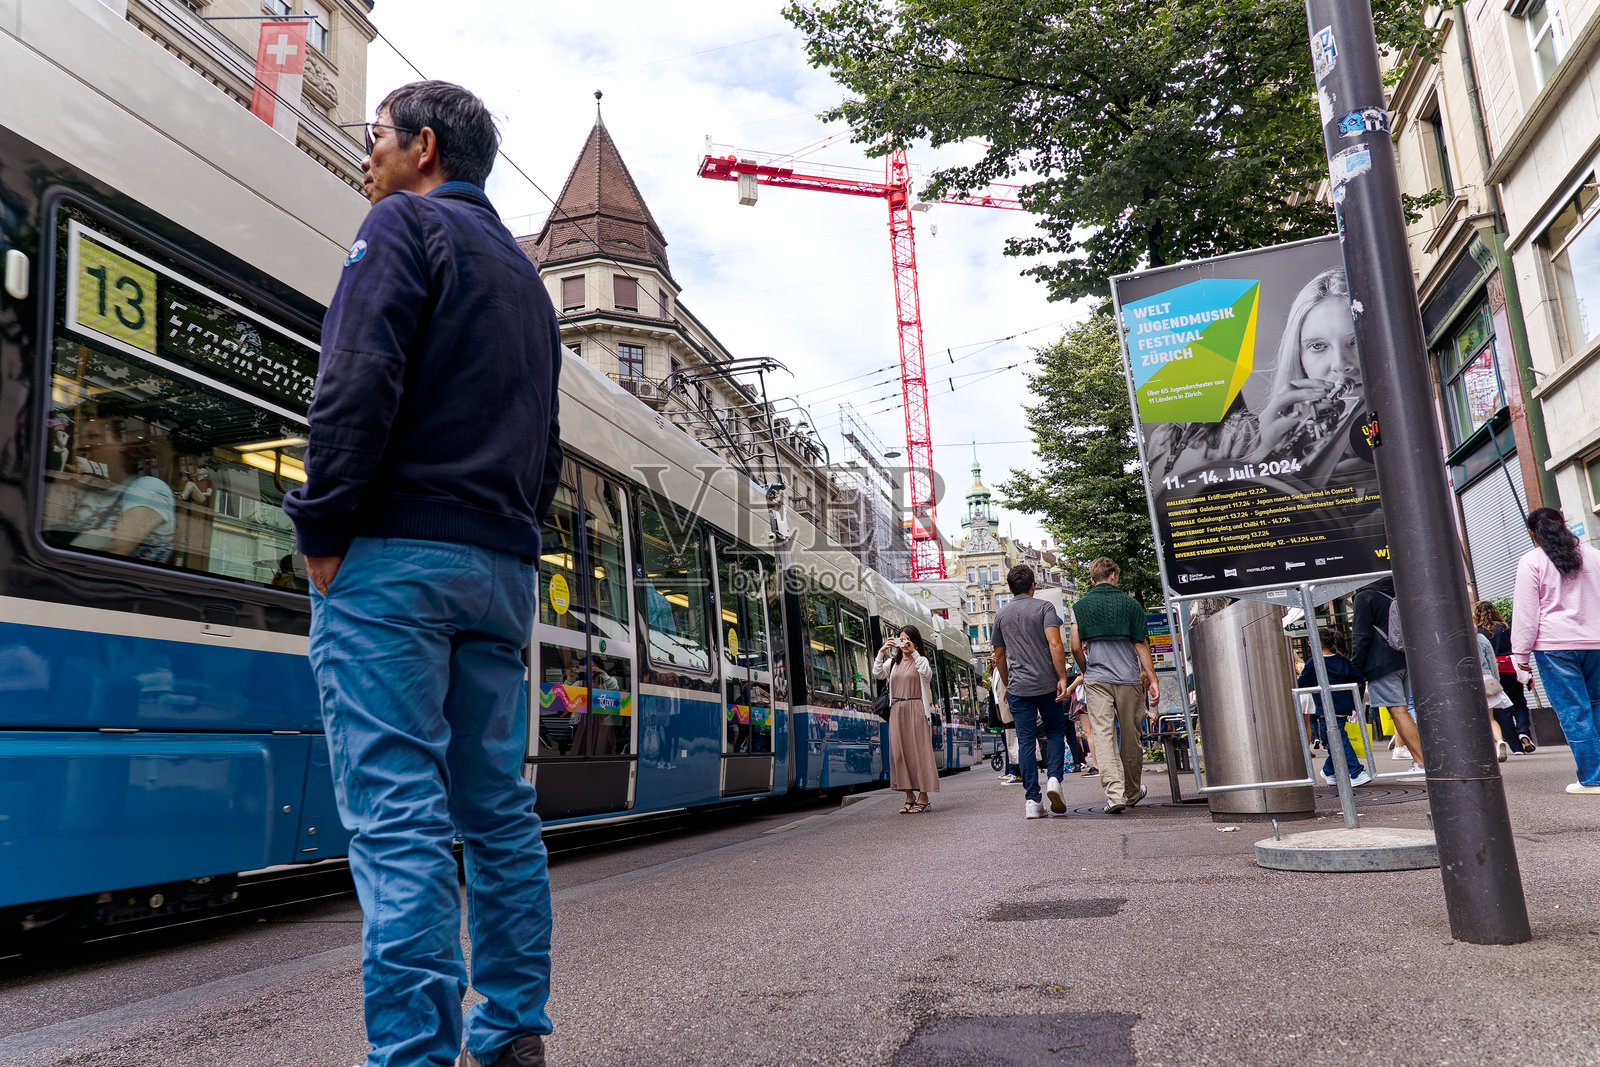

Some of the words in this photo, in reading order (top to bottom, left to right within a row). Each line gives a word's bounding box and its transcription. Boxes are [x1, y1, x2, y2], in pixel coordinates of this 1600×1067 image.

[86, 265, 145, 330] 13
[1133, 302, 1171, 319] WELT
[1137, 307, 1235, 335] JUGENDMUSIK
[1138, 330, 1204, 351] FESTIVAL
[1140, 347, 1193, 367] ZÜRICH
[1147, 389, 1160, 397] Über
[1170, 381, 1214, 393] Jugendorchester
[1156, 394, 1178, 403] Ländern
[1184, 391, 1204, 399] Zürich.
[1162, 475, 1185, 490] 11.
[1199, 470, 1224, 484] 14.
[1227, 464, 1256, 481] Juli
[1258, 458, 1302, 477] 2024
[1166, 496, 1206, 506] HALLENSTADION
[1208, 491, 1248, 501] Eröffnungsfeier
[1168, 508, 1198, 517] KUNSTHAUS
[1292, 490, 1324, 500] Switzerland
[1331, 486, 1354, 495] Concert
[1170, 519, 1196, 528] TONHALLE
[1254, 506, 1296, 516] Symphonisches
[1297, 500, 1334, 510] Blasorchester
[1336, 496, 1364, 505] Schweizer
[1172, 528, 1204, 538] MÜNSTERHOF
[1207, 524, 1232, 533] Festplatz
[1243, 520, 1259, 528] Chilbi
[1174, 538, 1220, 548] BAHNHOFSTRASSE
[1196, 547, 1226, 556] STANDORTE
[1227, 540, 1276, 551] Wettspielvorträge
